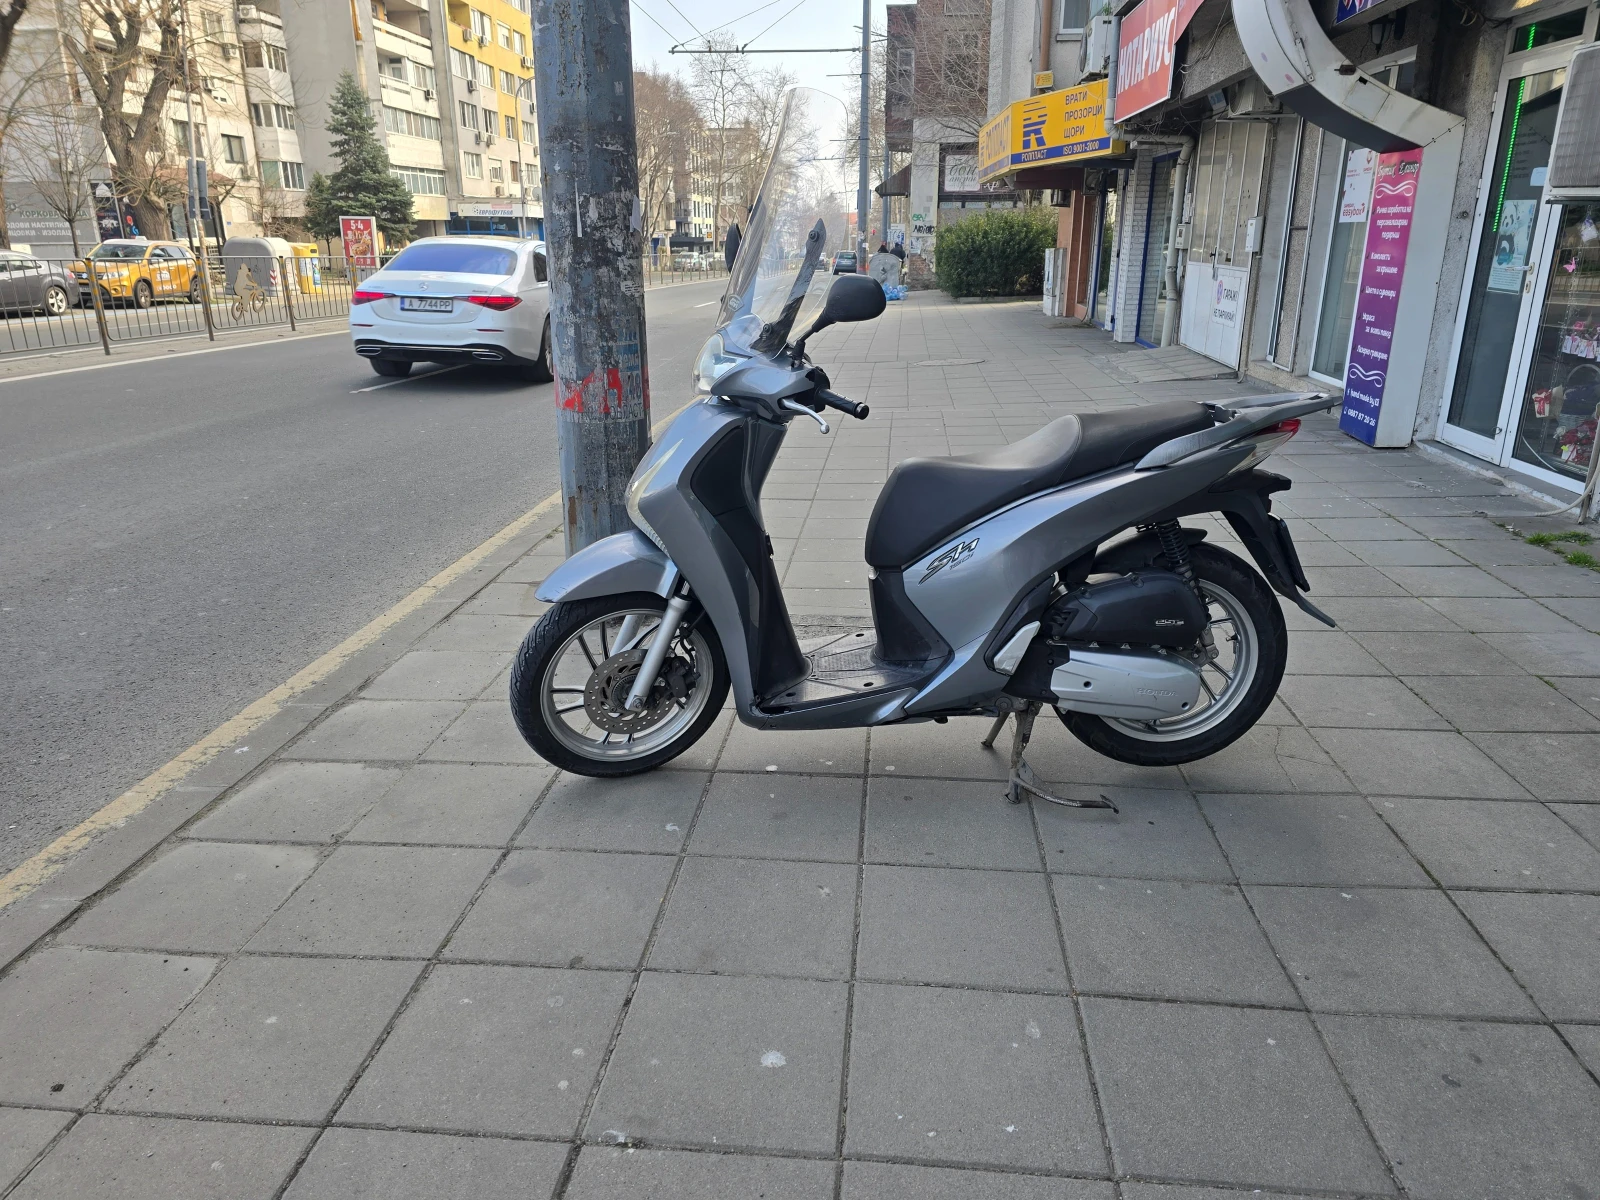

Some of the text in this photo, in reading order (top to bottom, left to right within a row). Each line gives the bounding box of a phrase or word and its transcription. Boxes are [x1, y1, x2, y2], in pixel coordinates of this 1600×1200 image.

[1117, 7, 1175, 94] НОТАРИУС
[1065, 91, 1088, 105] ВРАТИ
[1064, 104, 1103, 122] ПРОЗОРЦИ
[1063, 125, 1085, 139] ЩОРИ
[1063, 141, 1100, 155] ISO 9001-2000
[6, 221, 30, 229] ОДОВИ
[918, 537, 980, 586] SH
[1137, 687, 1178, 697] HONDA
